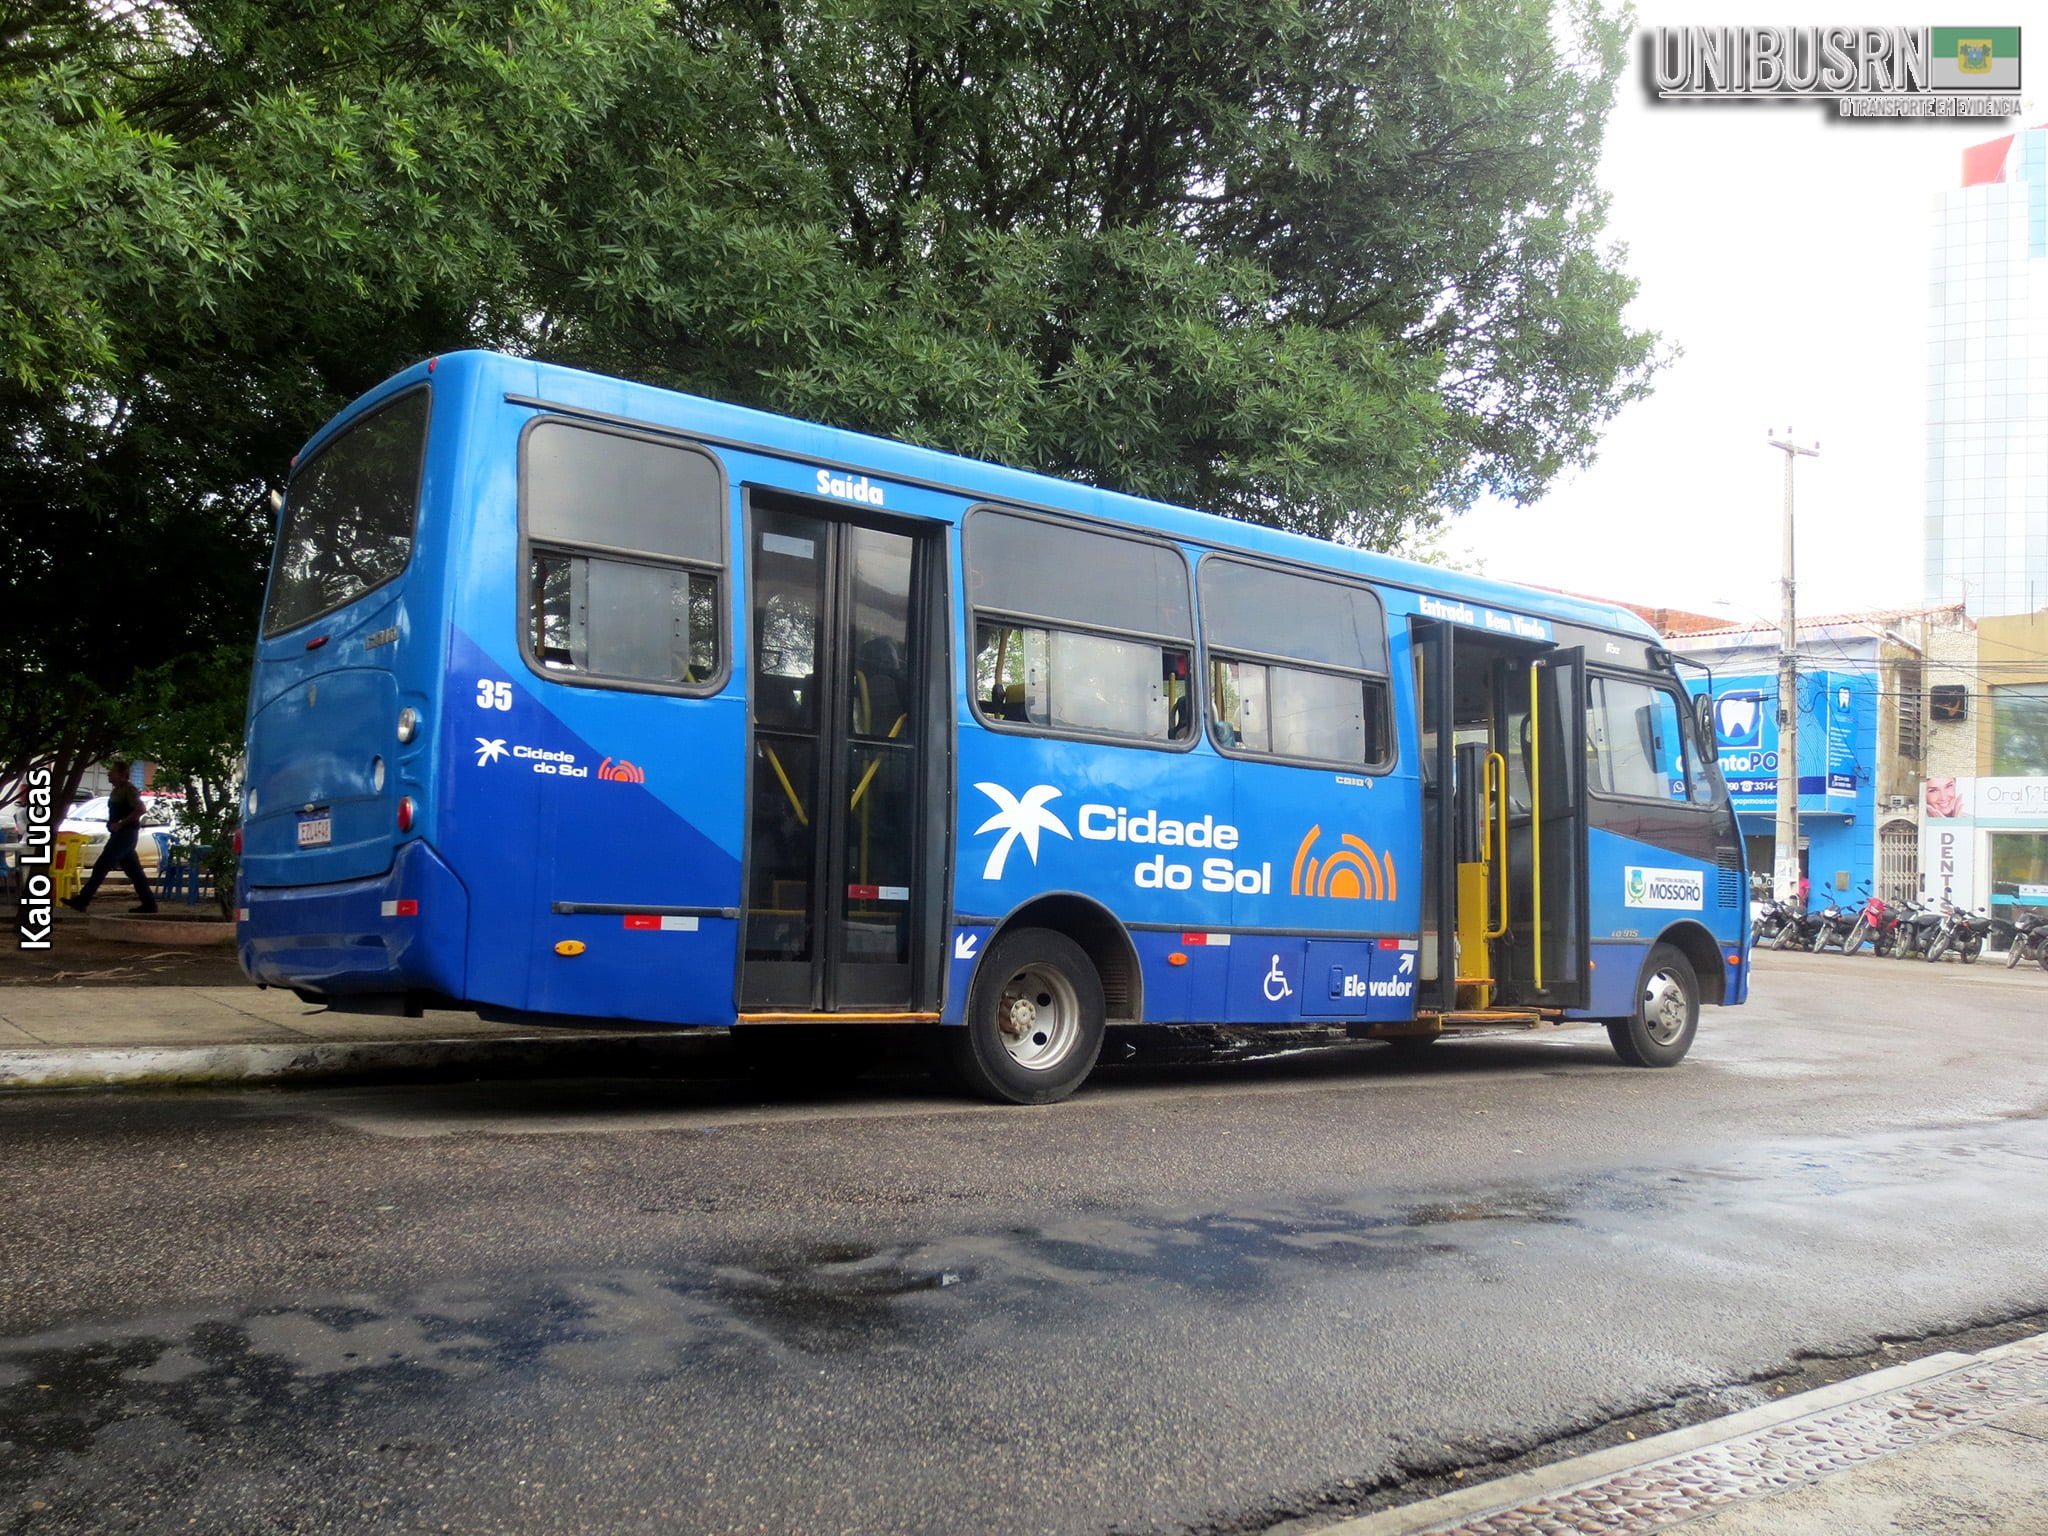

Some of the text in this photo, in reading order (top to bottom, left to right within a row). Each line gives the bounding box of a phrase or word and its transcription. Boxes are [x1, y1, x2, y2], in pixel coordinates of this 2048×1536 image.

[816, 469, 884, 505] Saída
[1419, 594, 1545, 640] Entrada Bem Vindo
[476, 679, 512, 711] 35
[513, 745, 576, 763] Cidade
[533, 762, 588, 777] do Sol
[1987, 786, 2023, 801] Oral
[1078, 803, 1239, 850] Cidade
[1134, 854, 1271, 894] do Sol
[1649, 882, 1701, 902] MOSSORÓ
